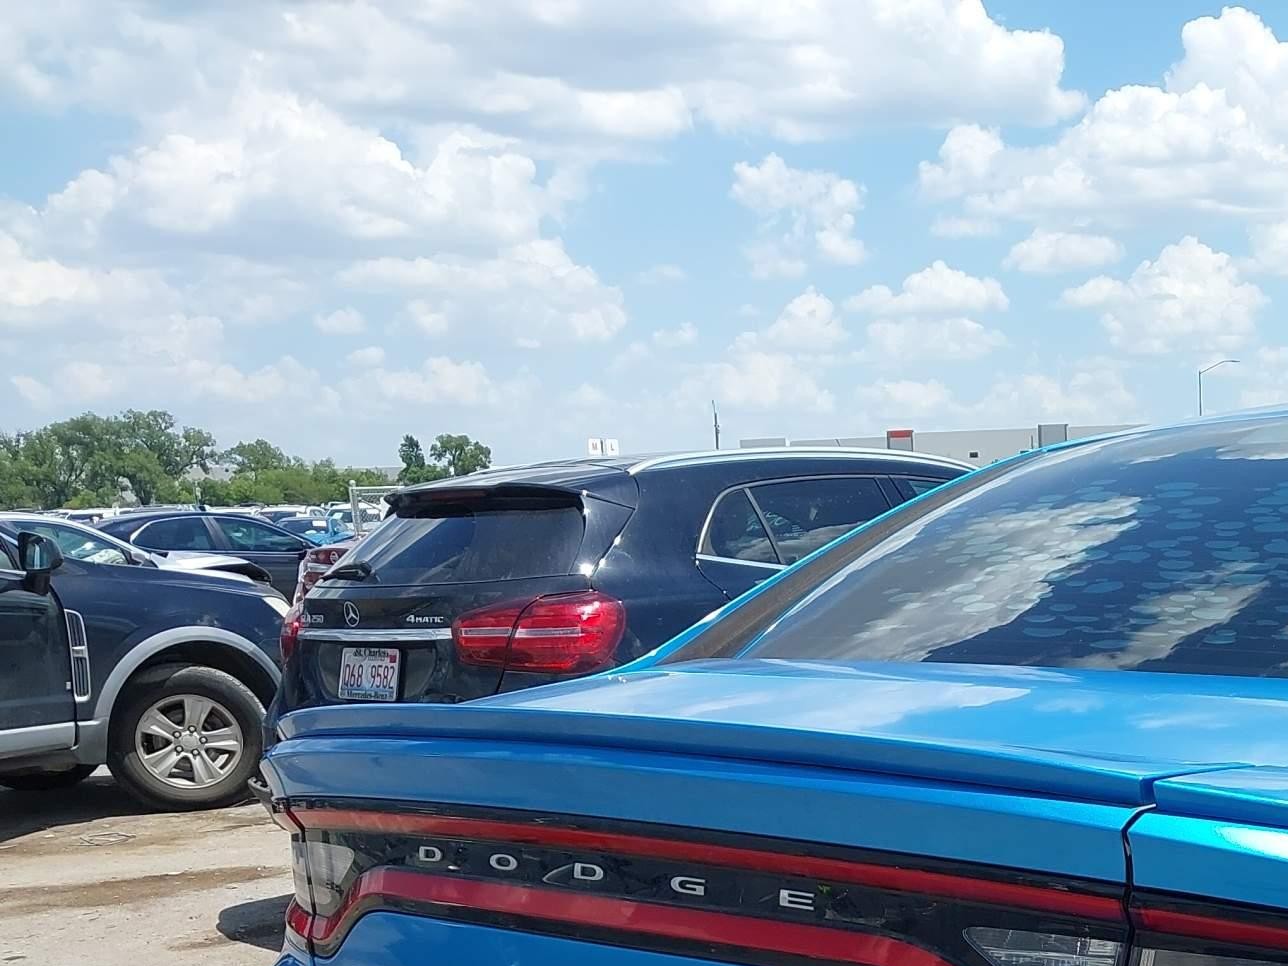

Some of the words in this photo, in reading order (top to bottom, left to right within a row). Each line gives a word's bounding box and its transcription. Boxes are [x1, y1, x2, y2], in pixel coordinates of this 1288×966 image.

[405, 614, 444, 624] 4MATIC
[369, 664, 395, 689] 9582
[418, 846, 815, 911] DODGE
